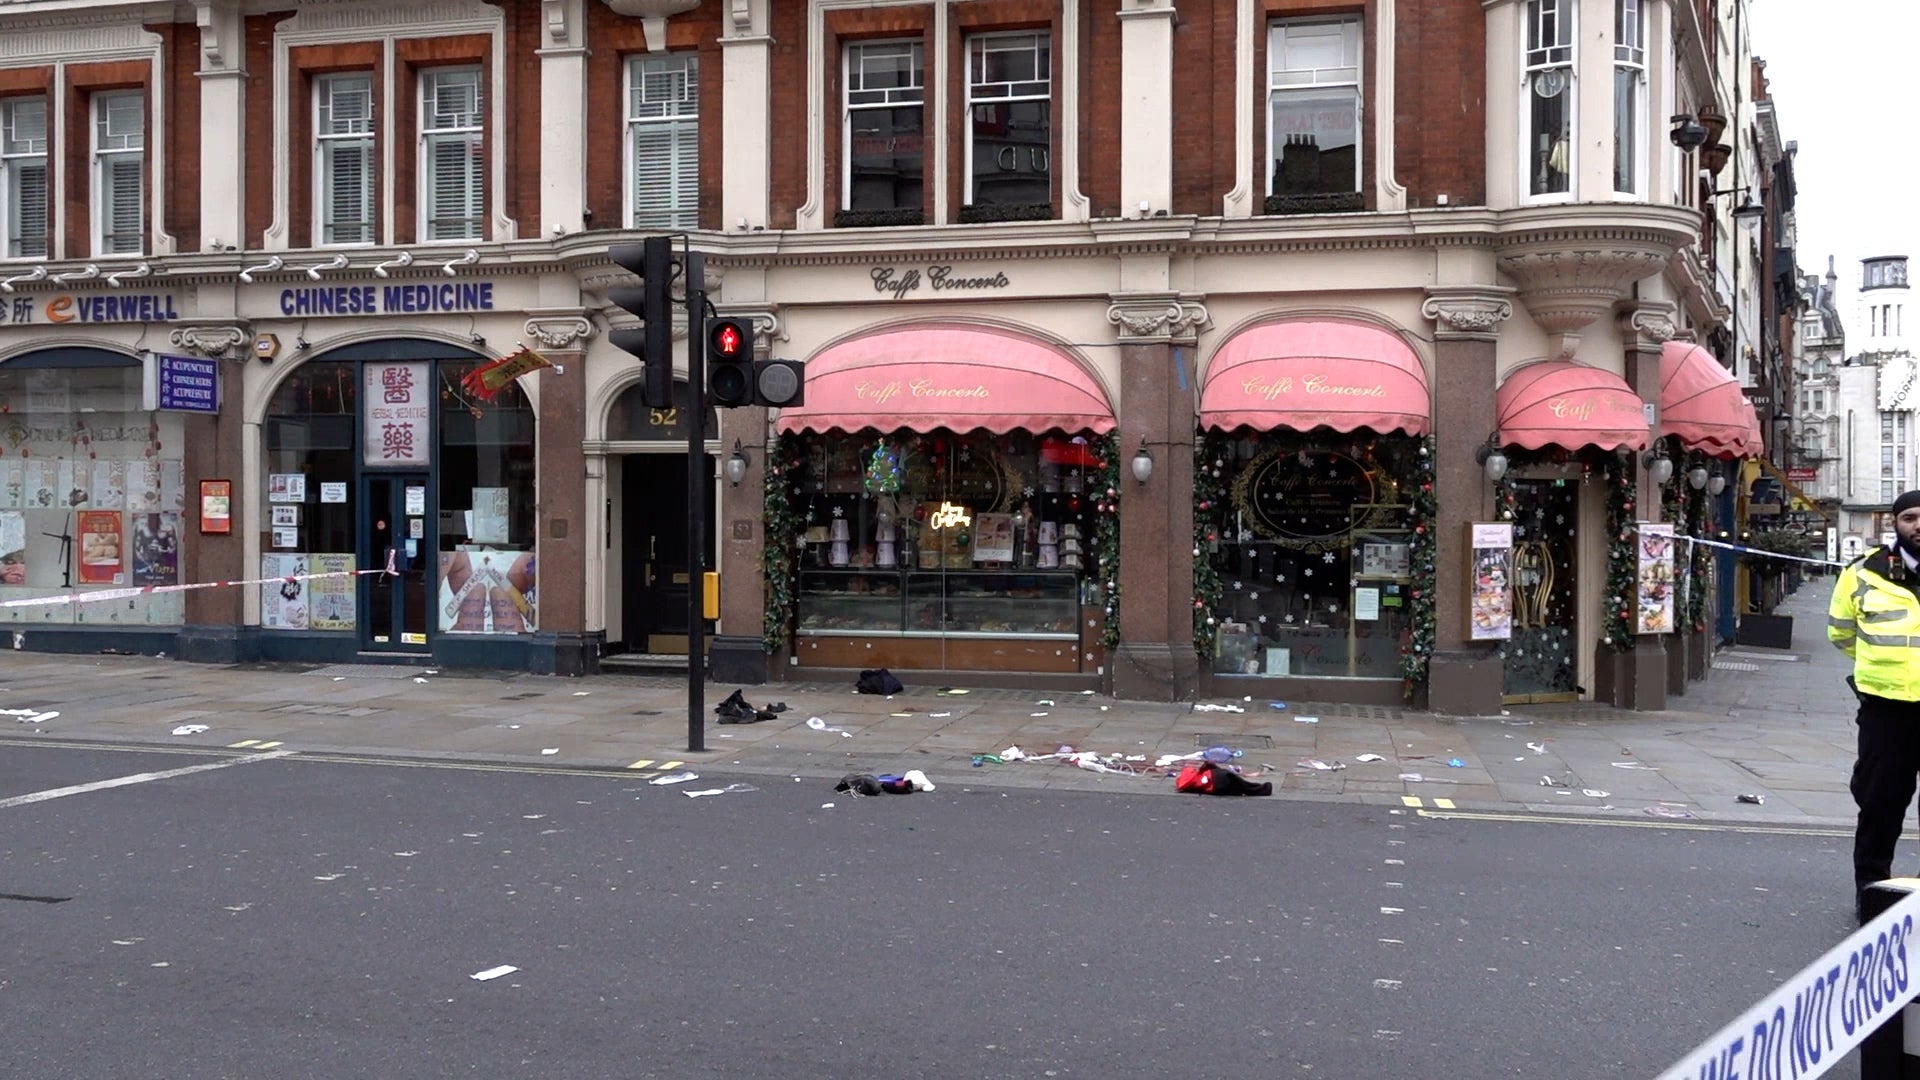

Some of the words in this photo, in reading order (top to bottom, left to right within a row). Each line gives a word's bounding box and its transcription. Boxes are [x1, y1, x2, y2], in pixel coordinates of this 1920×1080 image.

[927, 266, 1010, 291] Concerto
[280, 288, 376, 315] CHINESE
[383, 283, 493, 311] MEDICINE
[172, 361, 214, 374] ACUPUNCTURE
[909, 379, 989, 398] Concerto
[1302, 374, 1387, 397] Concerto
[649, 408, 677, 425] 52
[1749, 1005, 1785, 1080] DO
[1789, 964, 1841, 1080] NOT
[1841, 914, 1913, 1036] CROSS
